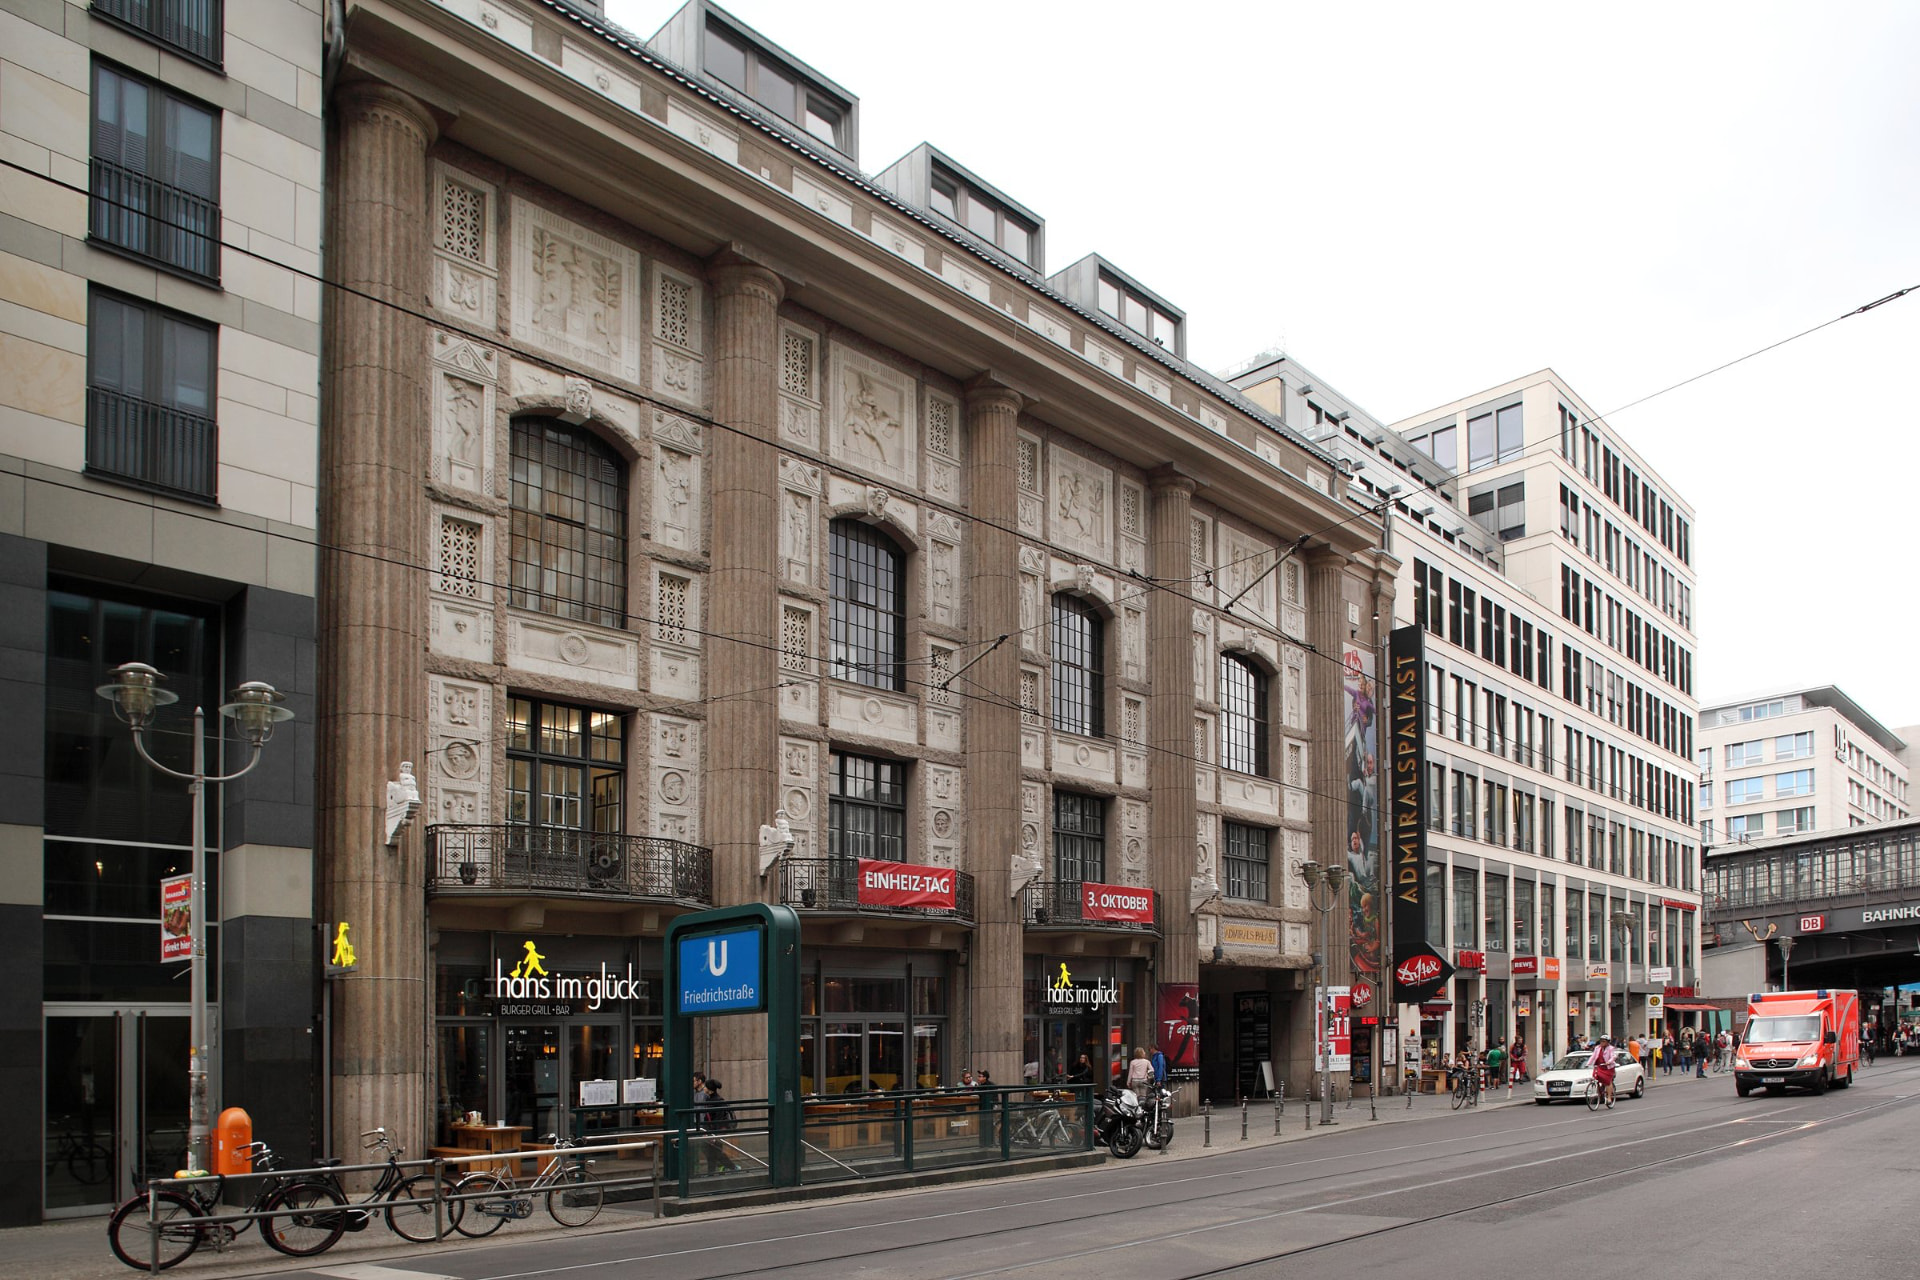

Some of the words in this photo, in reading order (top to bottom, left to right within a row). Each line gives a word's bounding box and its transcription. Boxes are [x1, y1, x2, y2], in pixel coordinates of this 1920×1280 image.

[1396, 656, 1418, 904] ADMIRALSPALAST
[865, 871, 950, 894] EINHEIZ-TAG
[1088, 891, 1099, 908] 3.
[1100, 893, 1148, 911] OKTOBER
[1802, 918, 1819, 930] DB
[164, 942, 180, 953] direkt
[180, 940, 191, 950] hier
[708, 940, 728, 977] U
[1459, 950, 1486, 969] REWE
[1514, 960, 1533, 969] REWE
[1593, 966, 1607, 974] dm
[496, 958, 551, 999] hans
[556, 973, 582, 999] im
[586, 961, 640, 1010] glück
[1047, 975, 1074, 1003] hans
[1075, 985, 1089, 1003] im
[1090, 976, 1118, 1011] glück
[684, 984, 754, 1005] Friedrichstraße
[501, 1004, 531, 1015] BURGER
[532, 1004, 550, 1015] GRILL
[555, 1004, 570, 1015] BAR
